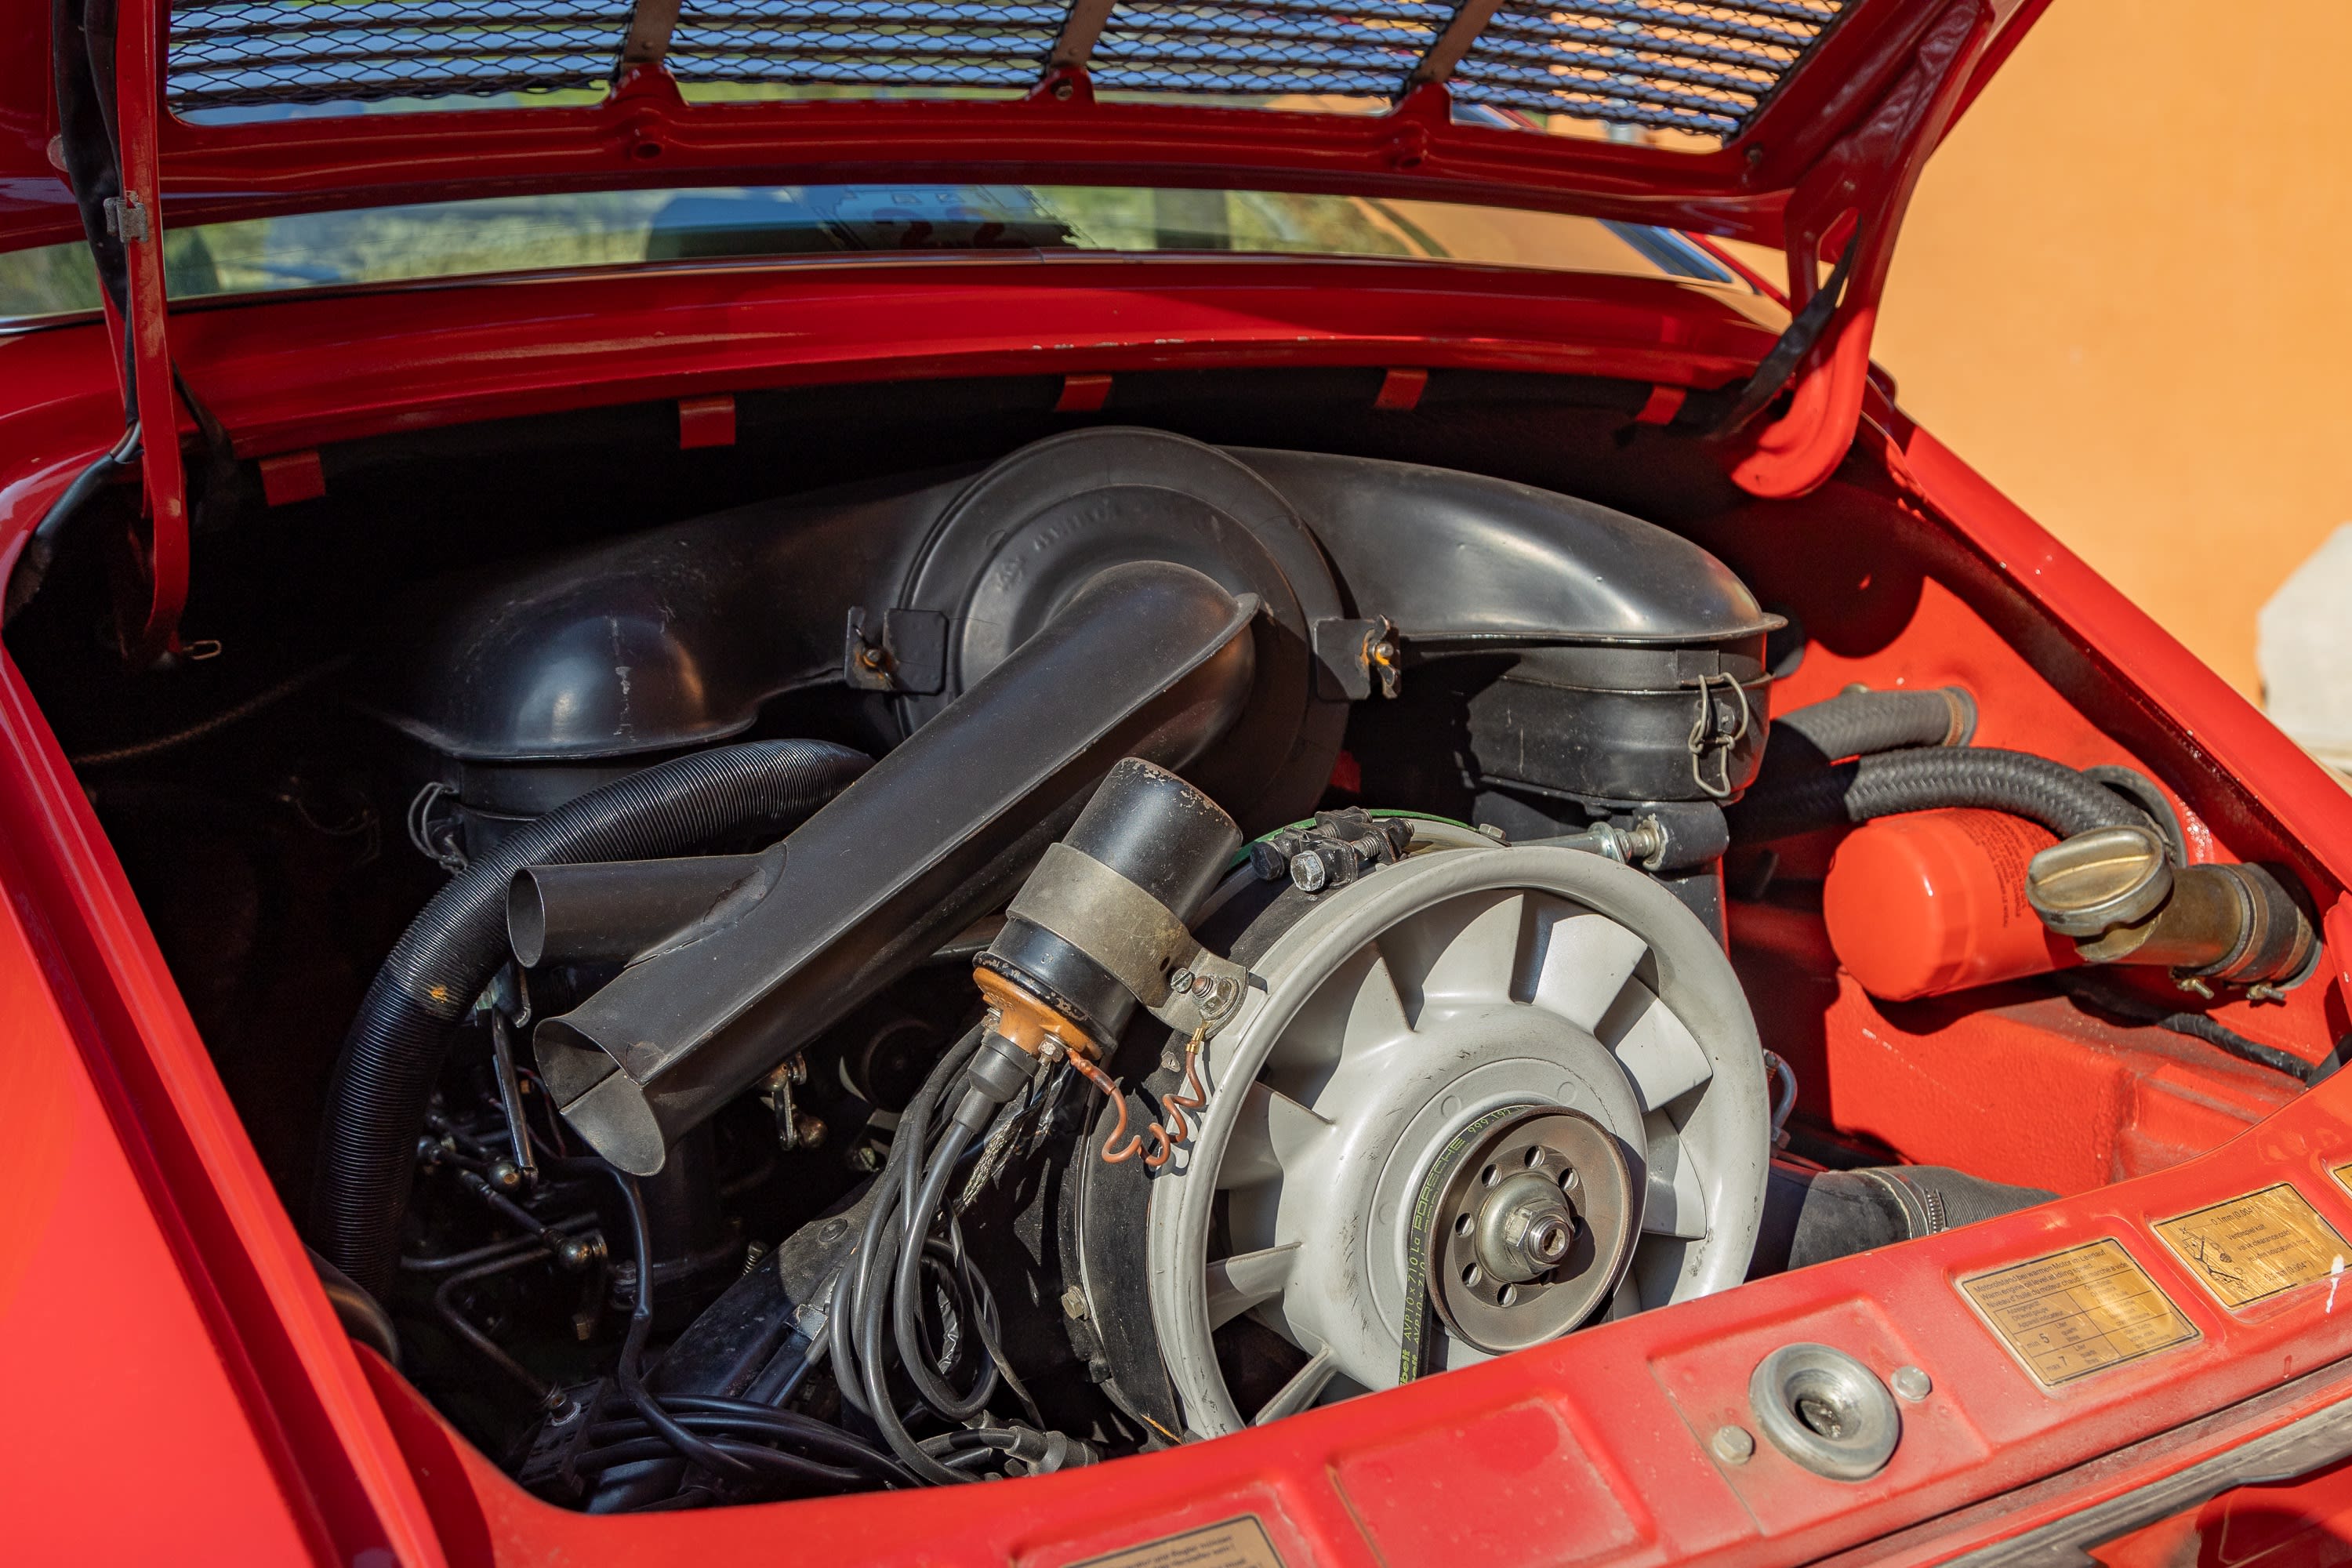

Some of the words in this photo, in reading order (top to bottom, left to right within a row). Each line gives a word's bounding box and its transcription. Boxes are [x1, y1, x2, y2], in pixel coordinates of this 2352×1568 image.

[1414, 1138, 1465, 1231] PORSCHE
[2252, 1234, 2279, 1247] clearance
[2027, 1266, 2053, 1277] warmen
[2052, 1259, 2072, 1269] Motor
[1980, 1290, 2002, 1300] Warm
[2001, 1284, 2025, 1295] engine
[2031, 1276, 2049, 1285] level
[2054, 1269, 2074, 1279] idling
[1987, 1298, 2011, 1308] Niveau
[2039, 1283, 2063, 1292] moteur
[2060, 1276, 2081, 1286] chaud
[2039, 1333, 2050, 1344] 5
[2058, 1356, 2067, 1367] 7
